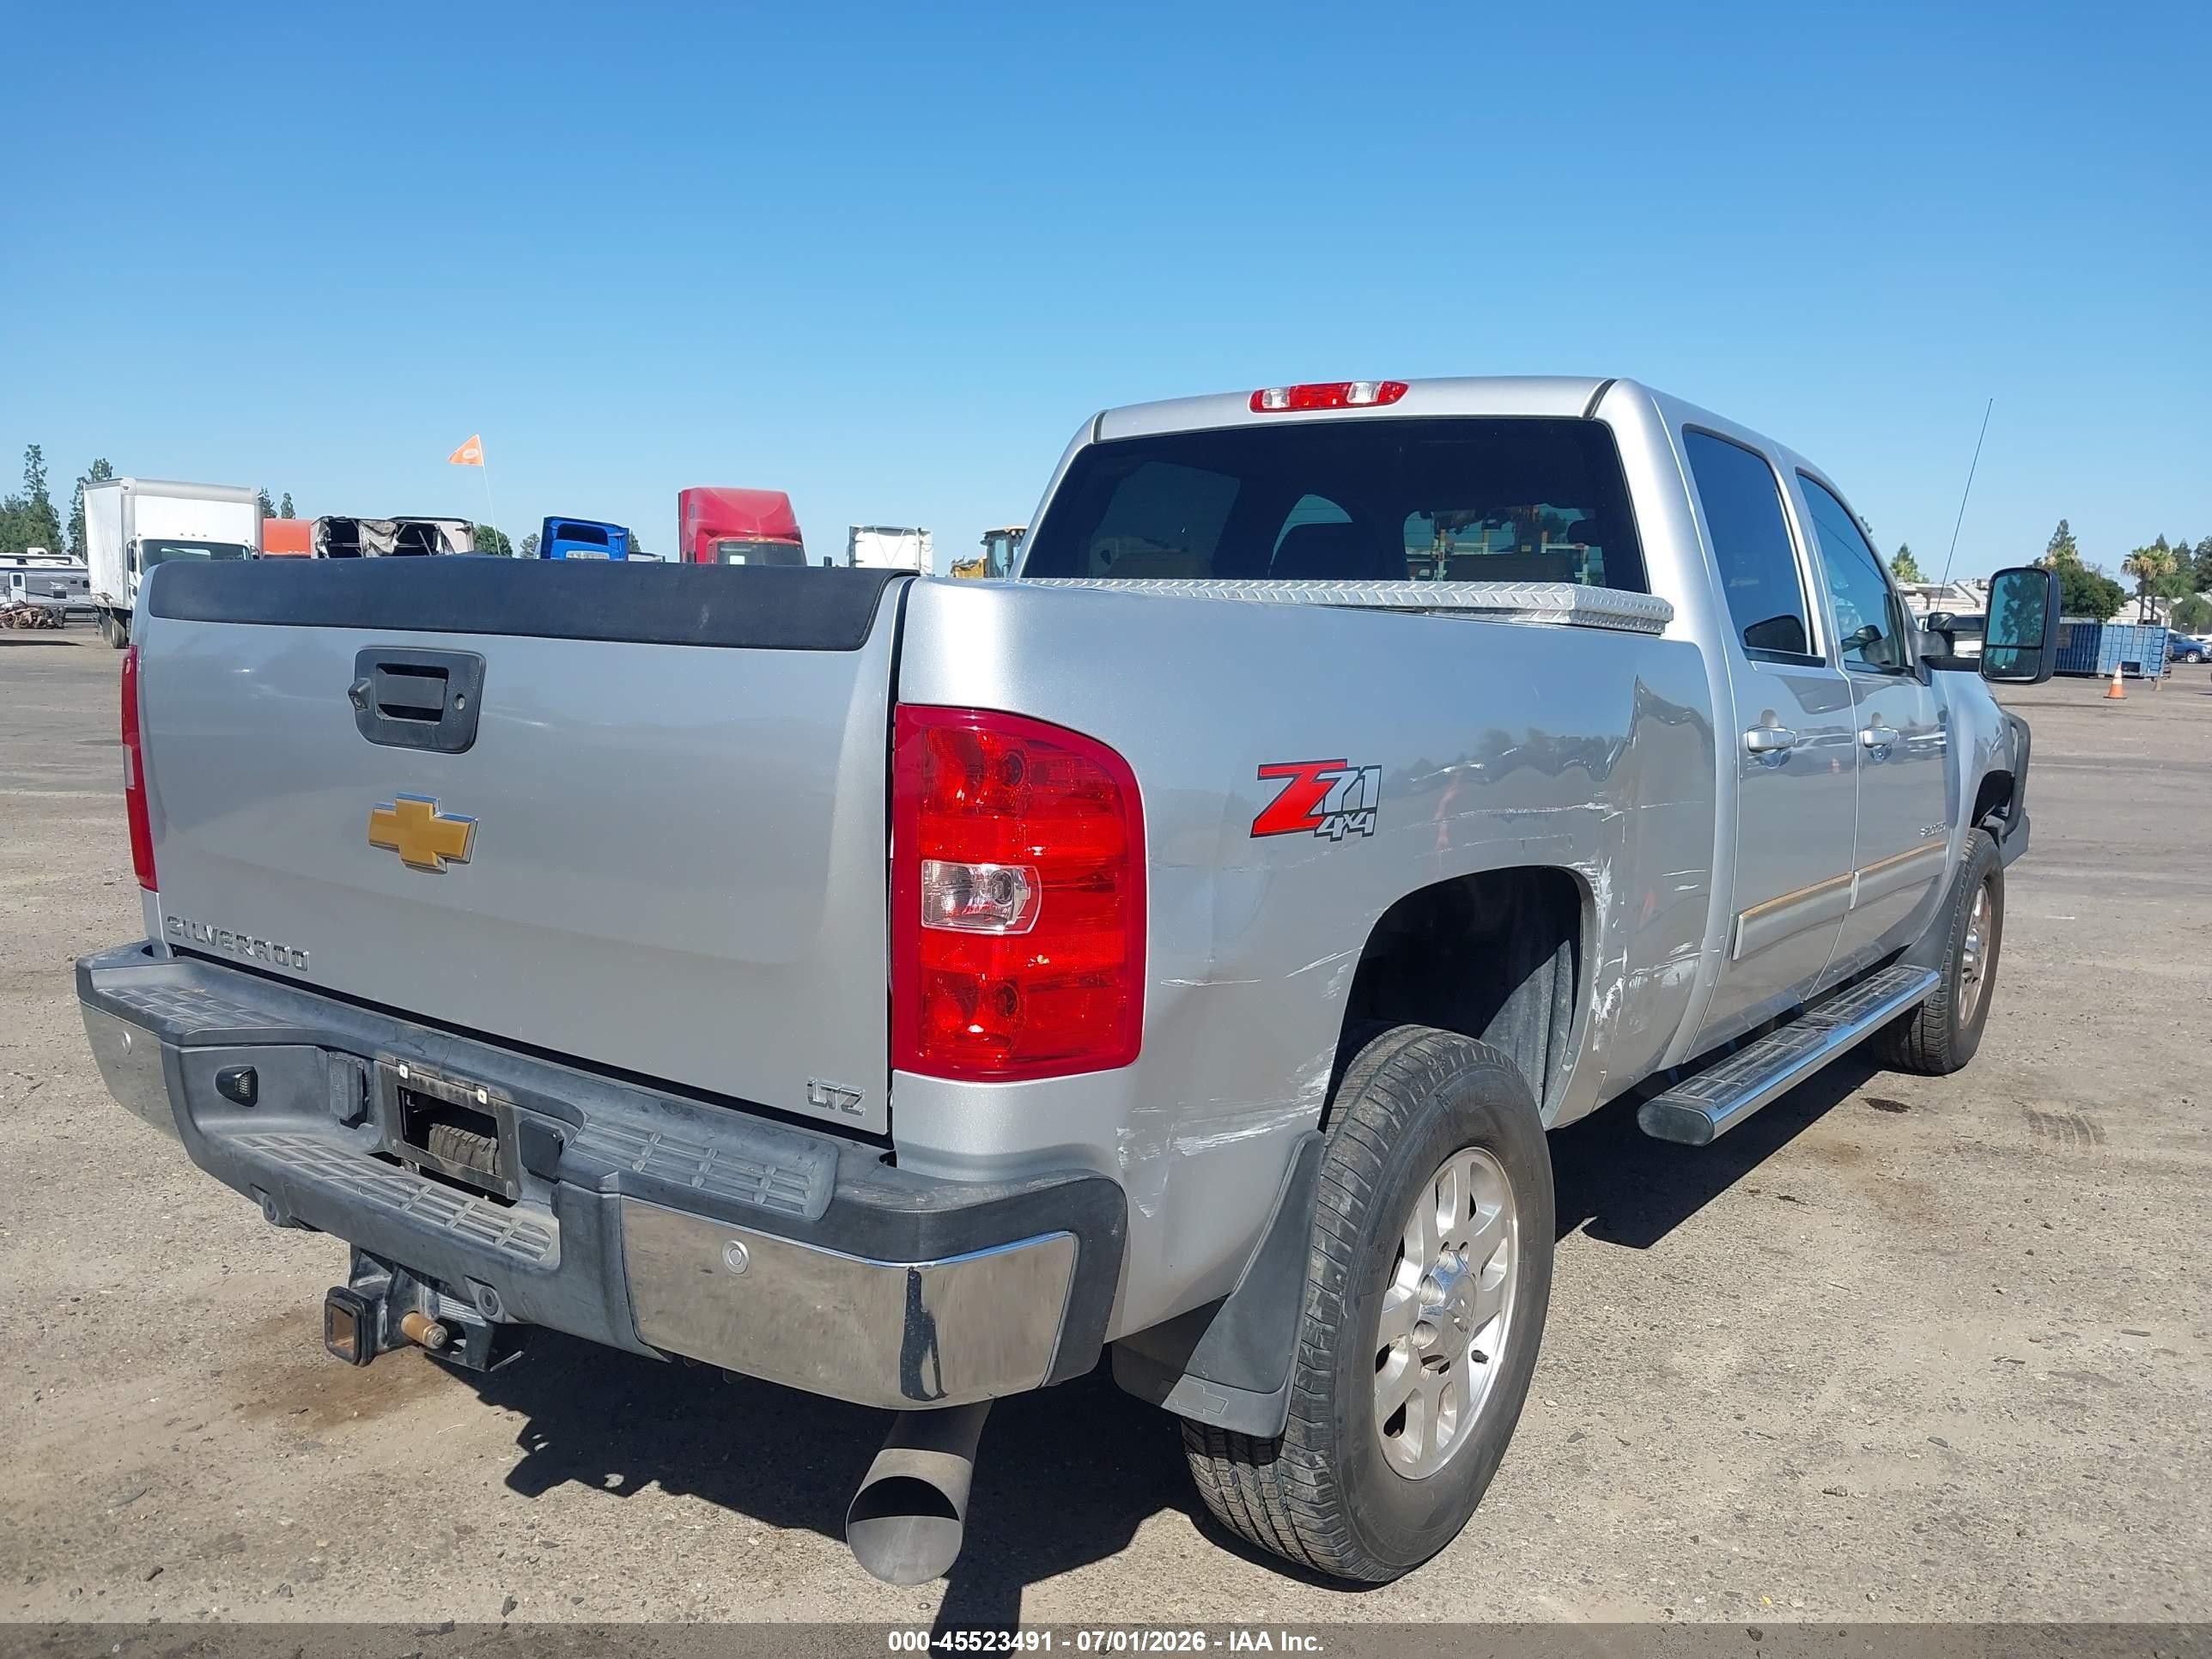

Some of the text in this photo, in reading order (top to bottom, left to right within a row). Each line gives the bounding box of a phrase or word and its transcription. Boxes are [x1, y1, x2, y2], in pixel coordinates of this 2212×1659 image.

[1250, 758, 1382, 838] Z71
[167, 915, 310, 972] SILVERADO
[806, 1079, 864, 1116] LTZ
